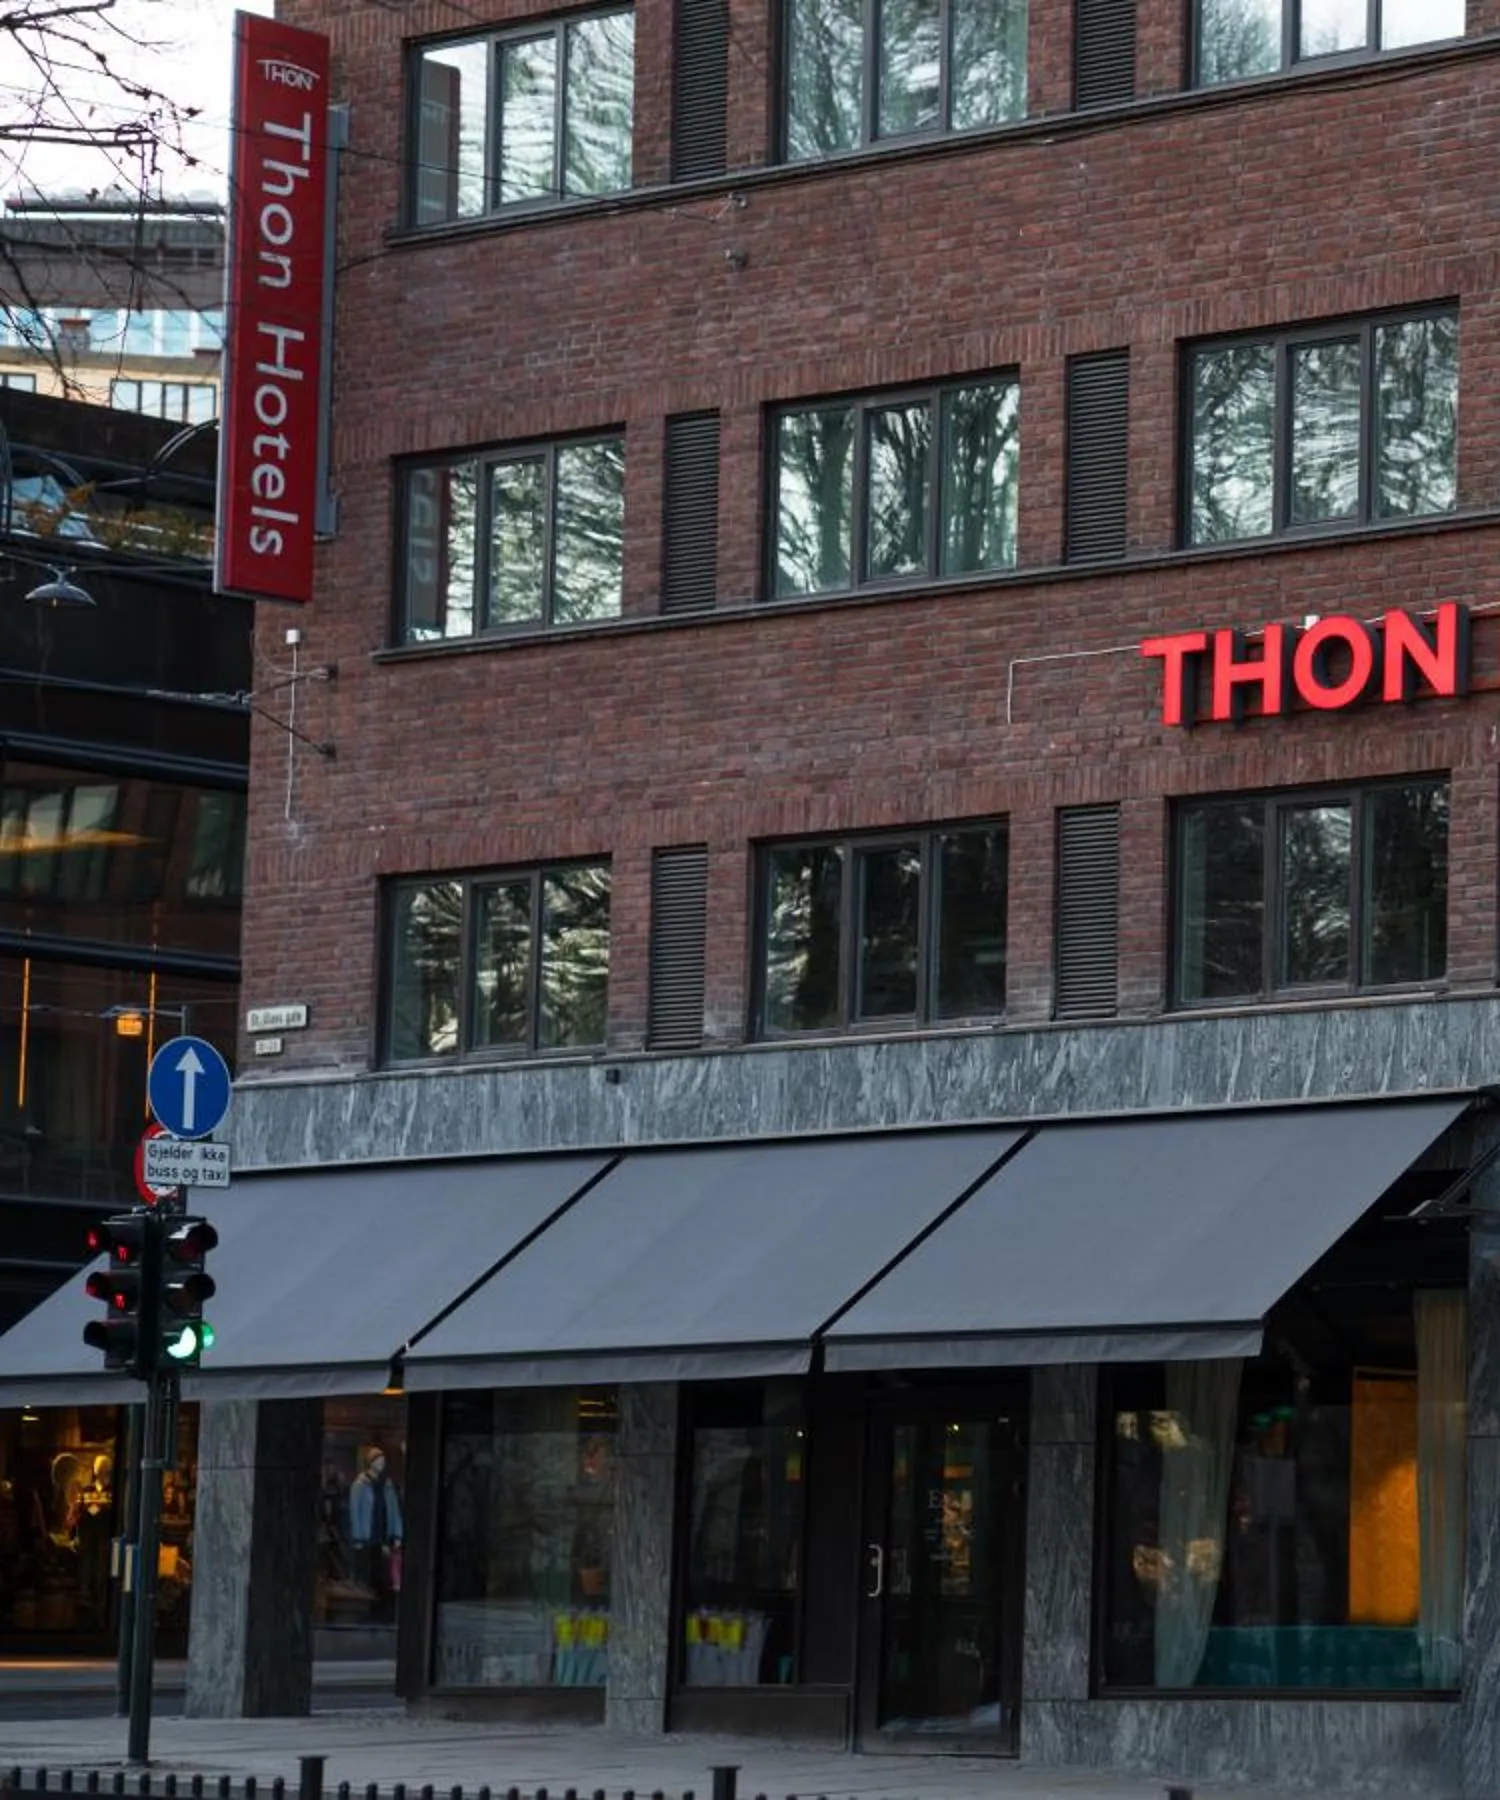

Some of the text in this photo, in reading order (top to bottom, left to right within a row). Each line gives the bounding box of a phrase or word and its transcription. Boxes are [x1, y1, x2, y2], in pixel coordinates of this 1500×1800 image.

[256, 58, 321, 92] THON
[248, 113, 311, 557] Thon Hotels
[1141, 602, 1472, 727] THON
[147, 1144, 226, 1168] Gjelder ikke
[148, 1164, 226, 1184] buss og taxi
